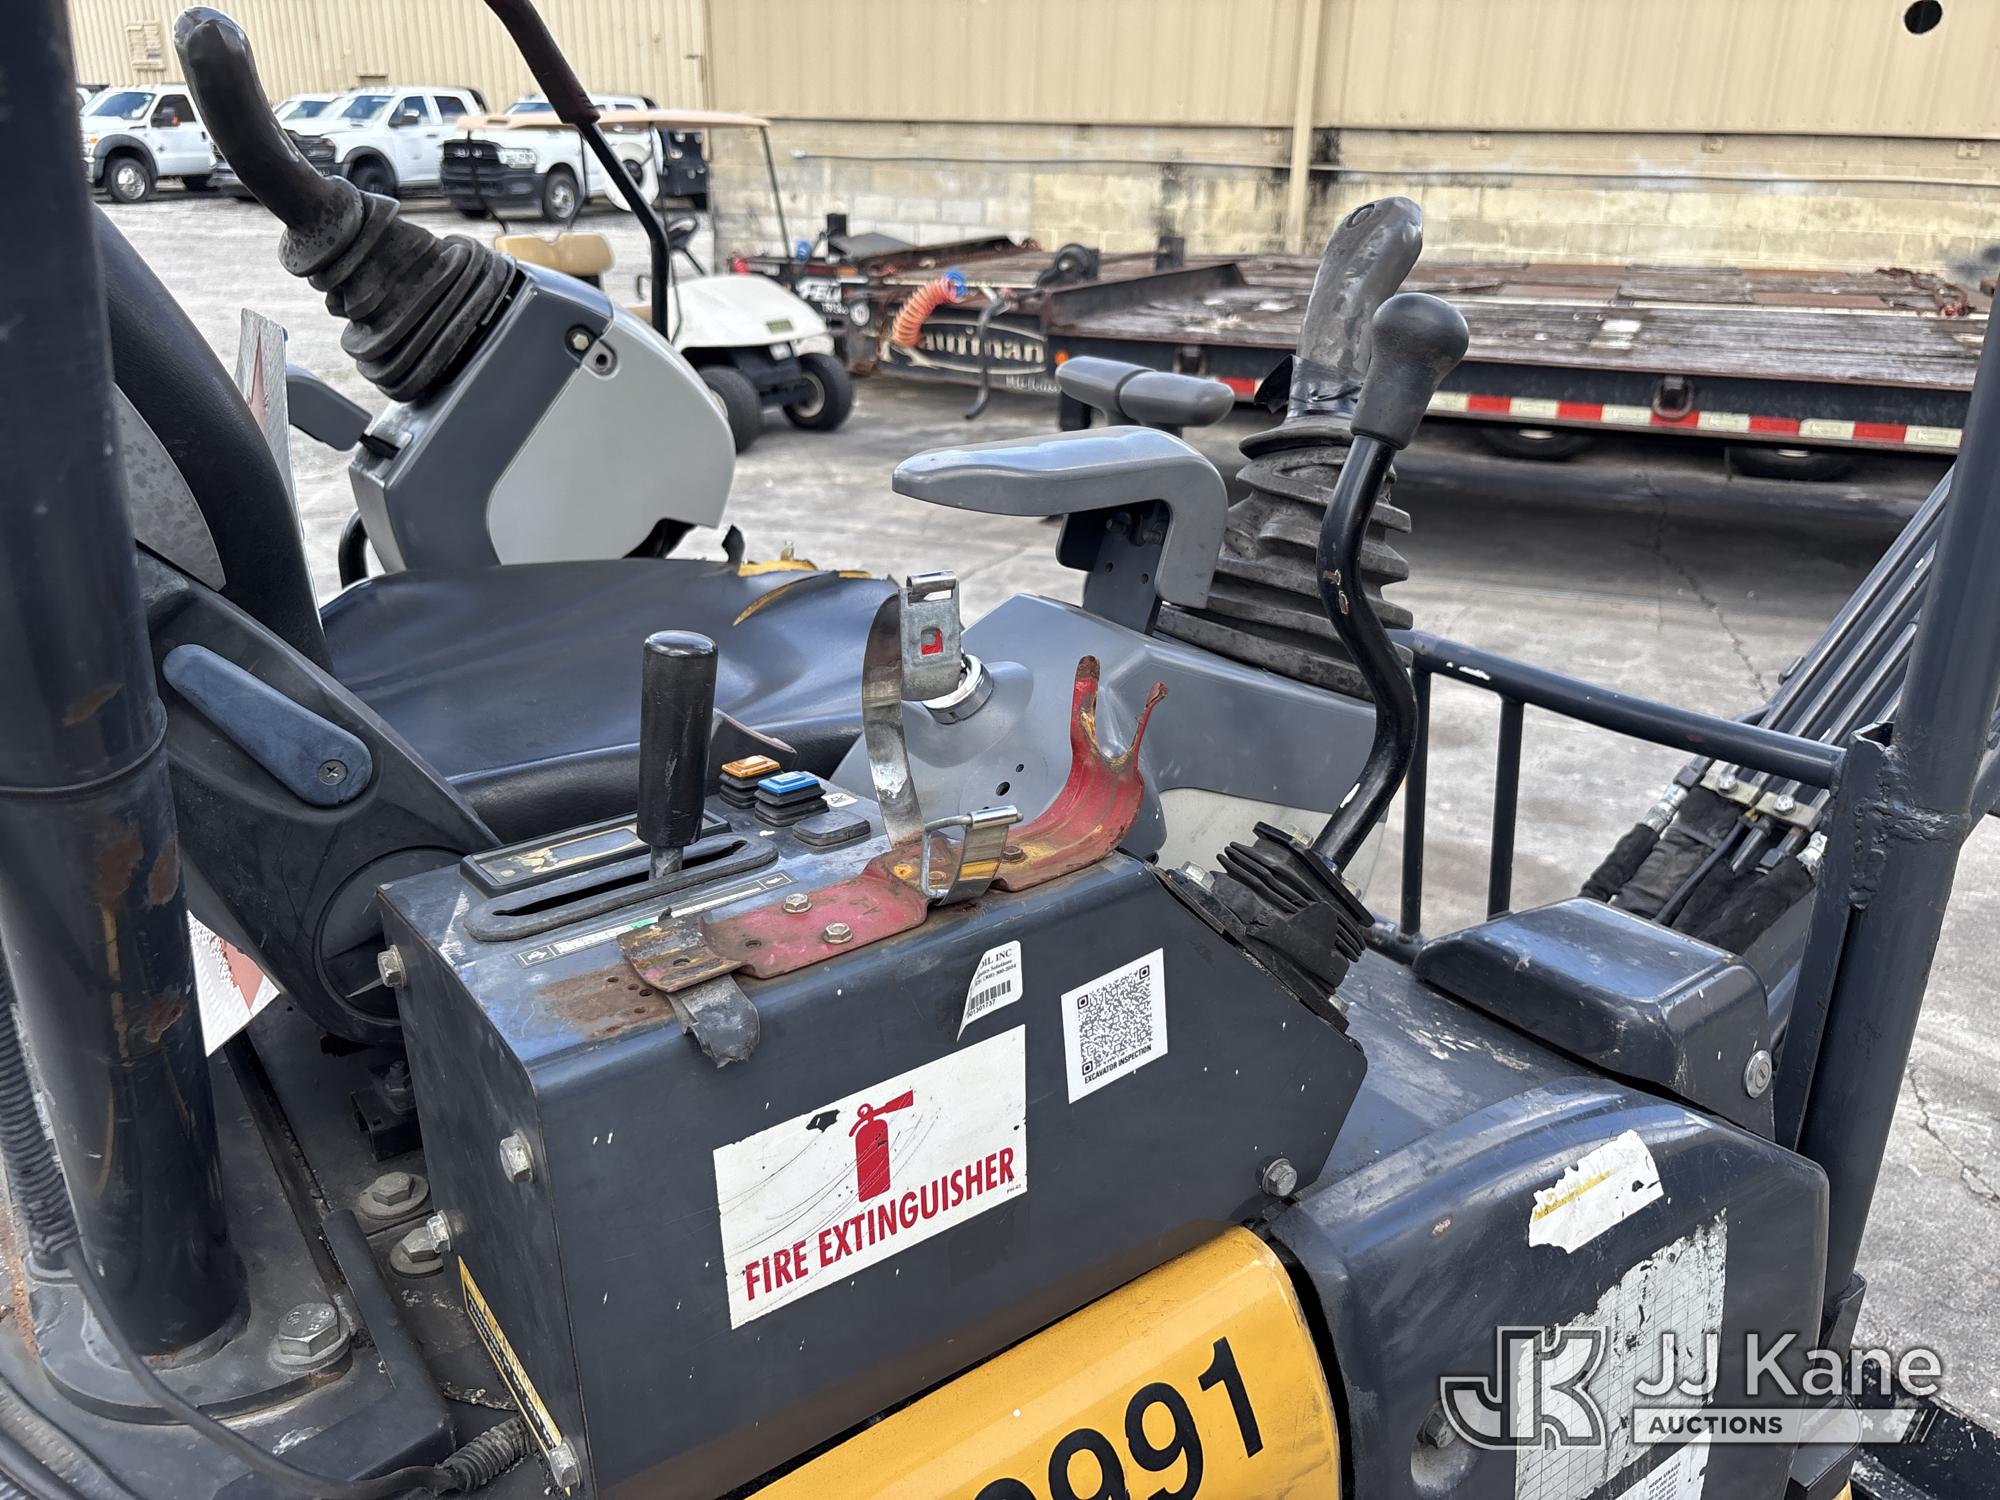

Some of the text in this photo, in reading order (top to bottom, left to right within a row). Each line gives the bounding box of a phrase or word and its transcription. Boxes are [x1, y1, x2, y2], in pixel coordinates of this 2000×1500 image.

[996, 948, 1012, 961] INC
[1084, 1043, 1152, 1084] EXCAVATOR INSPECTION
[745, 1147, 1015, 1301] FIRE EXTINGUISHER
